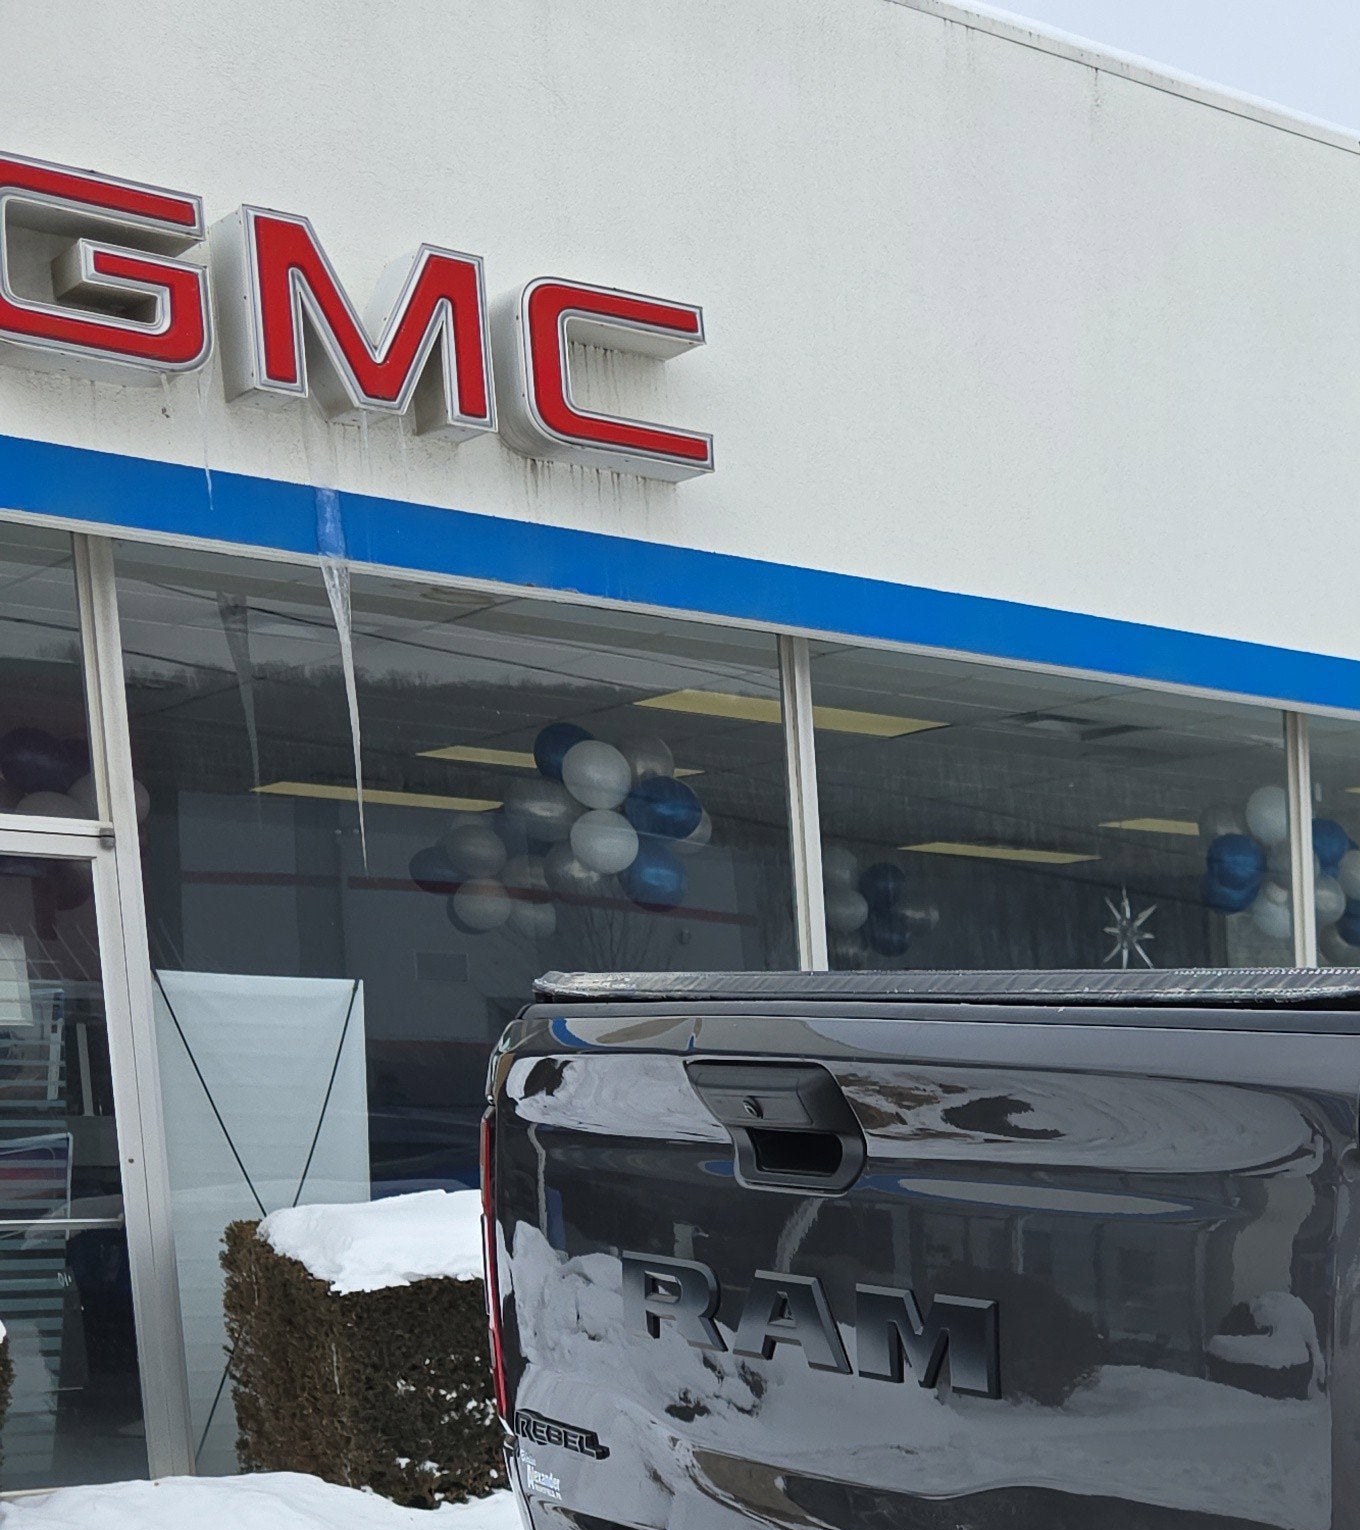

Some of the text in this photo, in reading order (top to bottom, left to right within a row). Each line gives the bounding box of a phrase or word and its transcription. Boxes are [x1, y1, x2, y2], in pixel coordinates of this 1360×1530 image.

[0, 150, 714, 474] GMC
[620, 1250, 1002, 1400] RAM
[514, 1409, 610, 1460] REBEL
